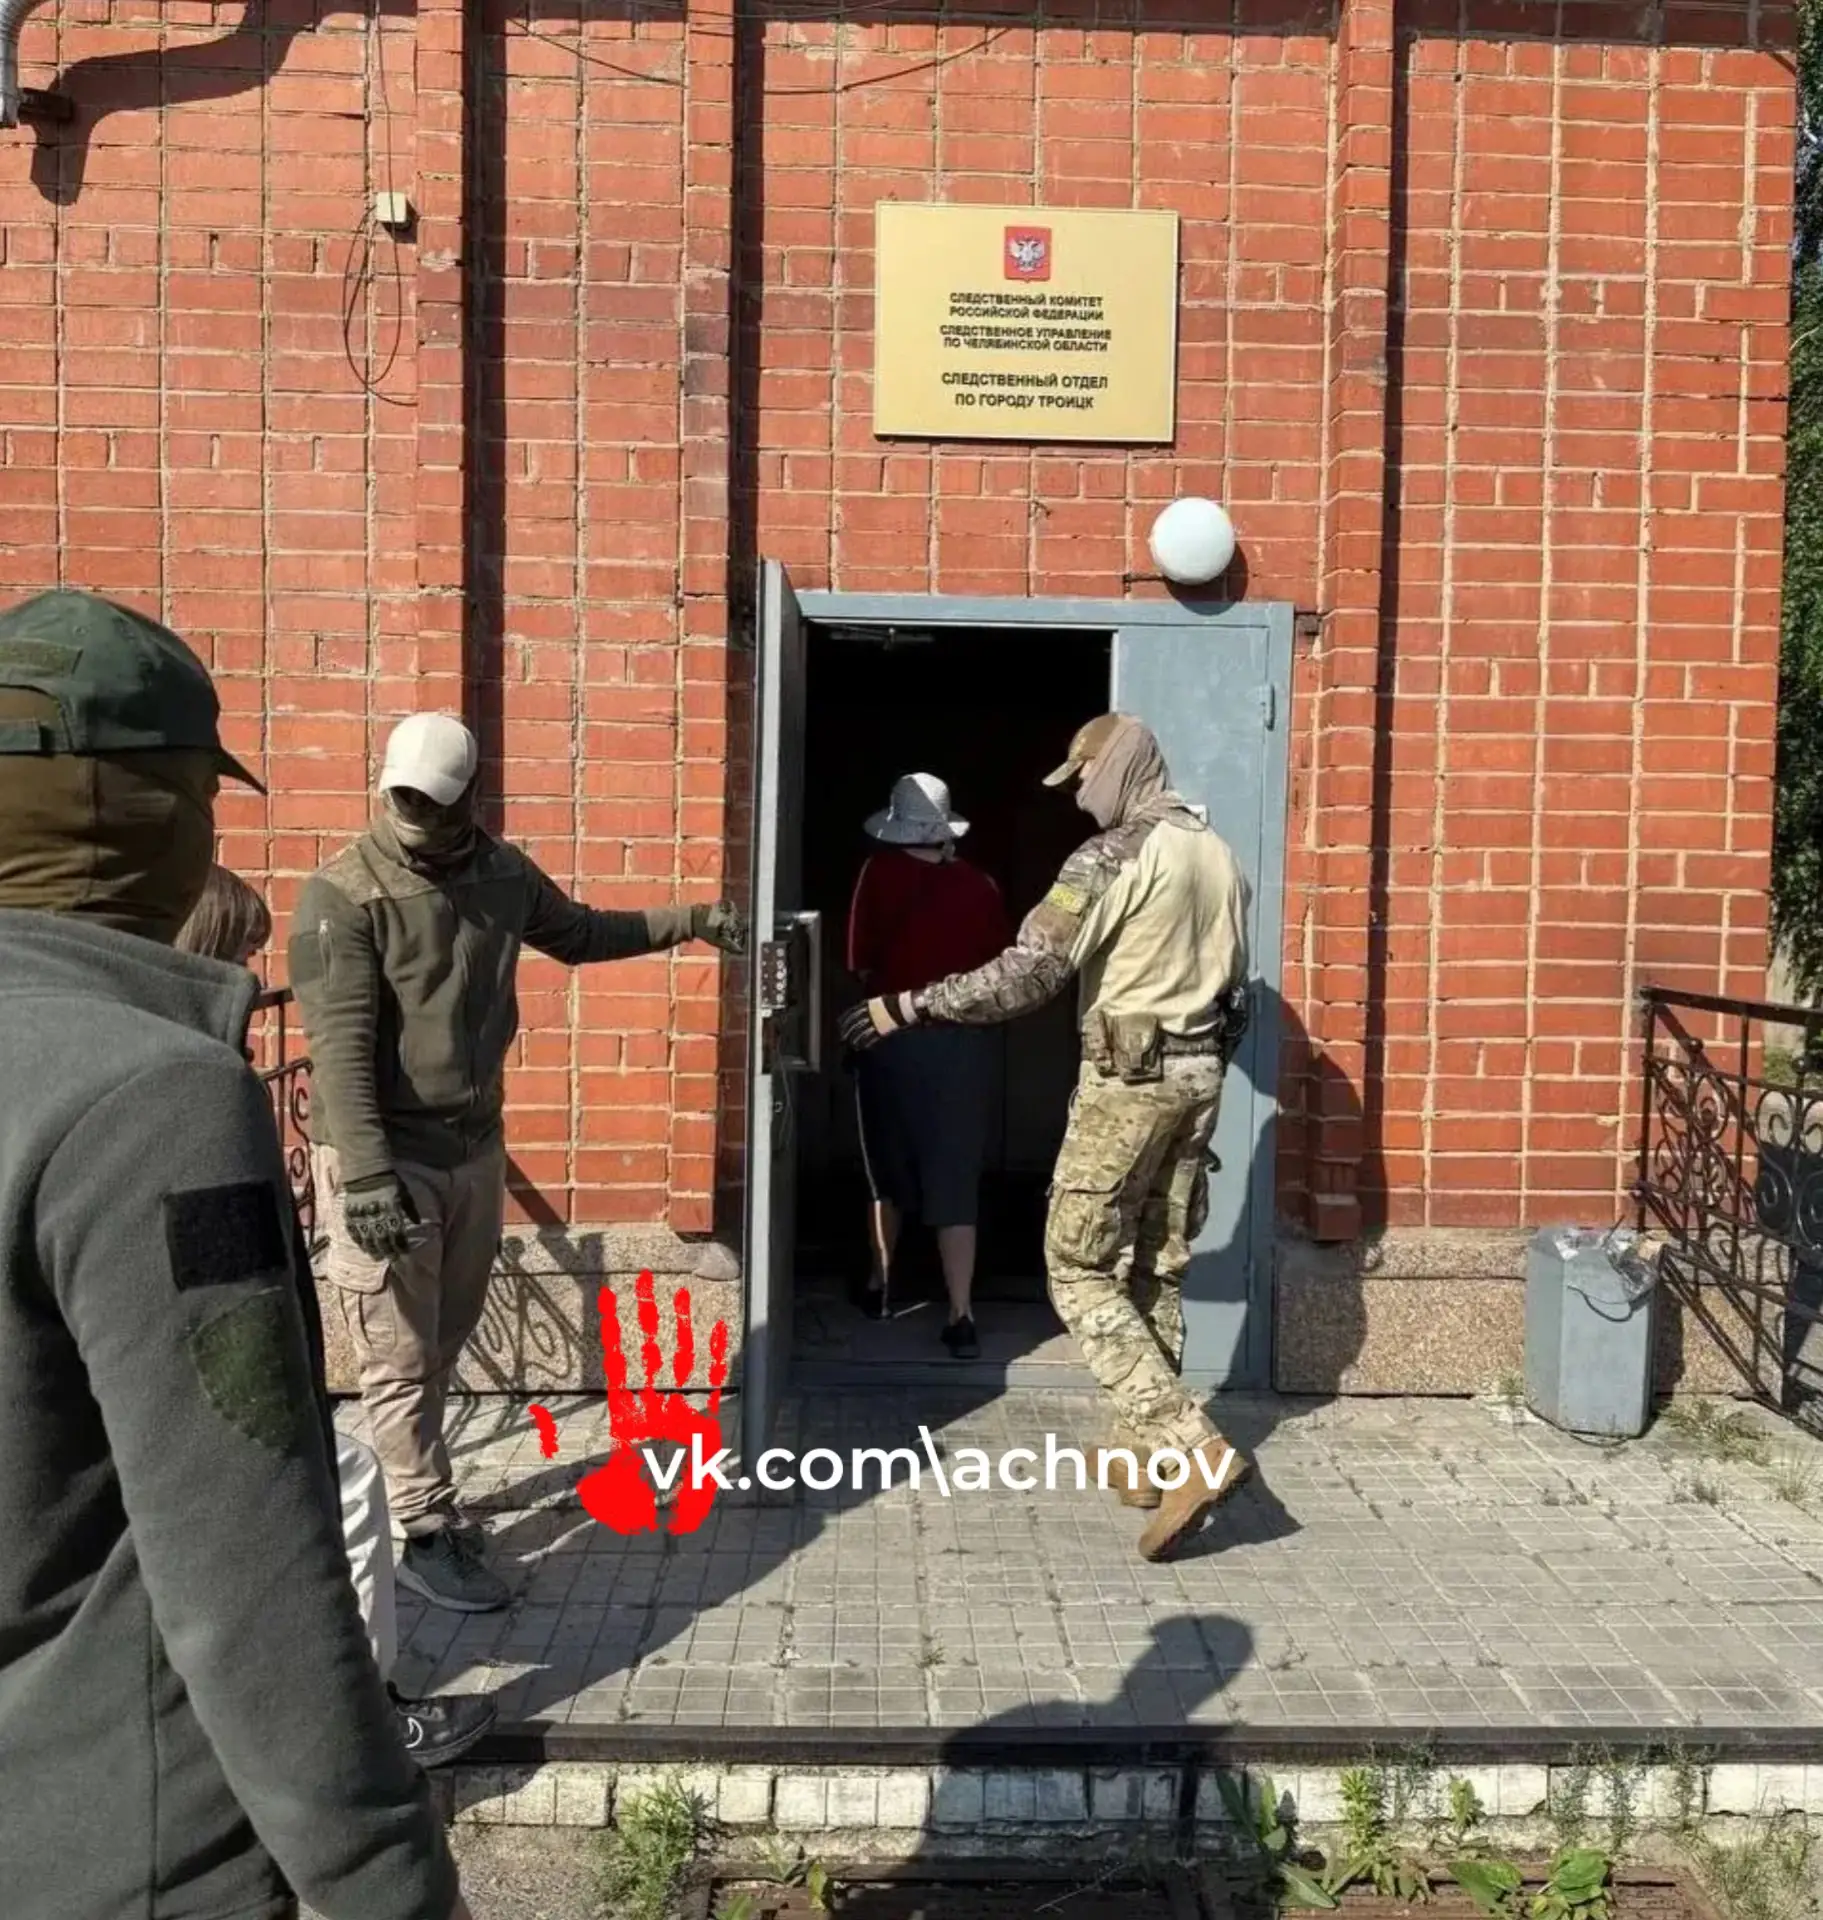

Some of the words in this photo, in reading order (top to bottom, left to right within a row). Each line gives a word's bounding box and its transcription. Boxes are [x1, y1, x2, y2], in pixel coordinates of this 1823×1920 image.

[950, 292, 1046, 306] СЛЕДСТВЕННЫЙ
[1050, 295, 1103, 307] КОМИТЕТ
[950, 306, 1029, 319] РОССИЙСКОЙ
[1032, 308, 1104, 321] ФЕДЕРАЦИИ
[940, 324, 1033, 338] СЛЕДСТВЕННОЕ
[1036, 327, 1111, 340] УПРАВЛЕНИЕ
[944, 337, 961, 349] ПО
[964, 337, 1049, 351] ЧЕЛЯБИНСКОЙ
[1053, 340, 1108, 352] ОБЛАСТИ
[941, 372, 1058, 388] СЛЕДСТВЕННЫЙ
[1061, 376, 1108, 389] ОТДЕЛ
[955, 393, 976, 406] ПО
[979, 393, 1034, 409] ГОРОДУ
[1038, 395, 1094, 410] ТРОИЦК
